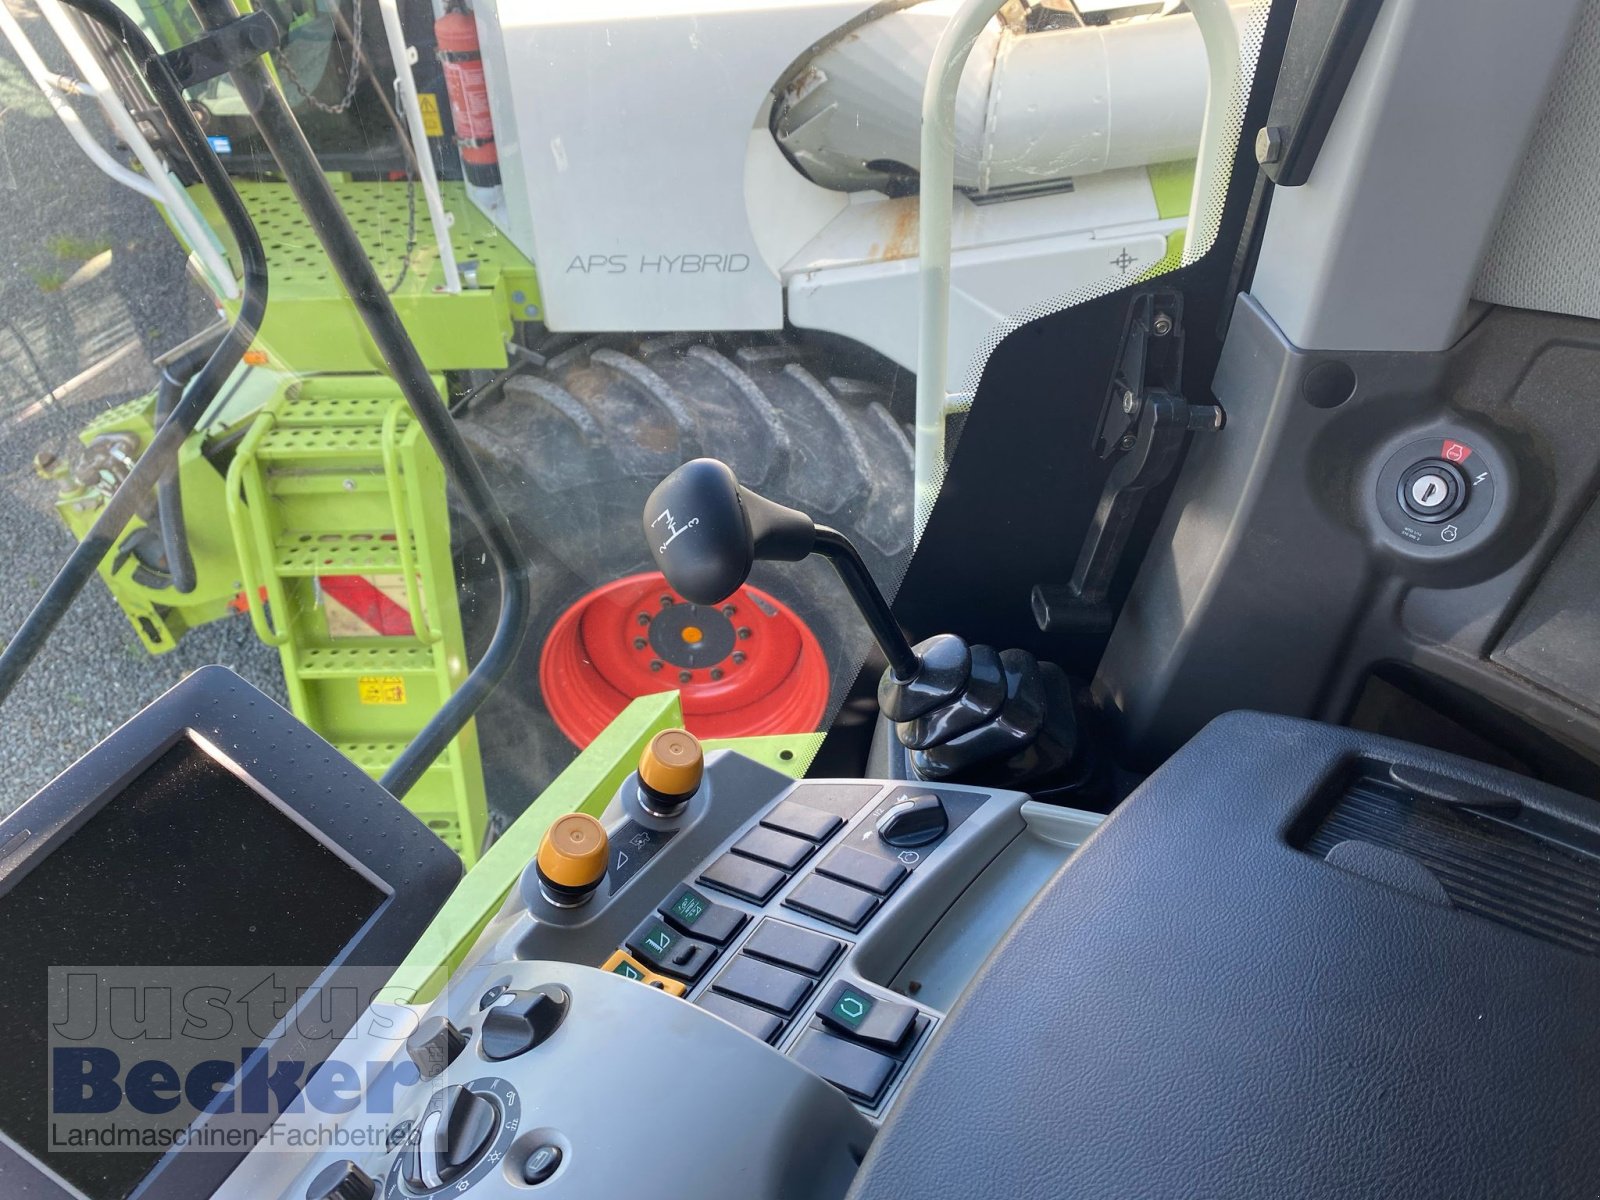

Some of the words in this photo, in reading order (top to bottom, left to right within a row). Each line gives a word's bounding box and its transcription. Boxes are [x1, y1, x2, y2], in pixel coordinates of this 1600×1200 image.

[566, 254, 628, 274] APS
[640, 253, 750, 273] HYBRID
[688, 517, 699, 528] 3
[659, 542, 667, 554] 2
